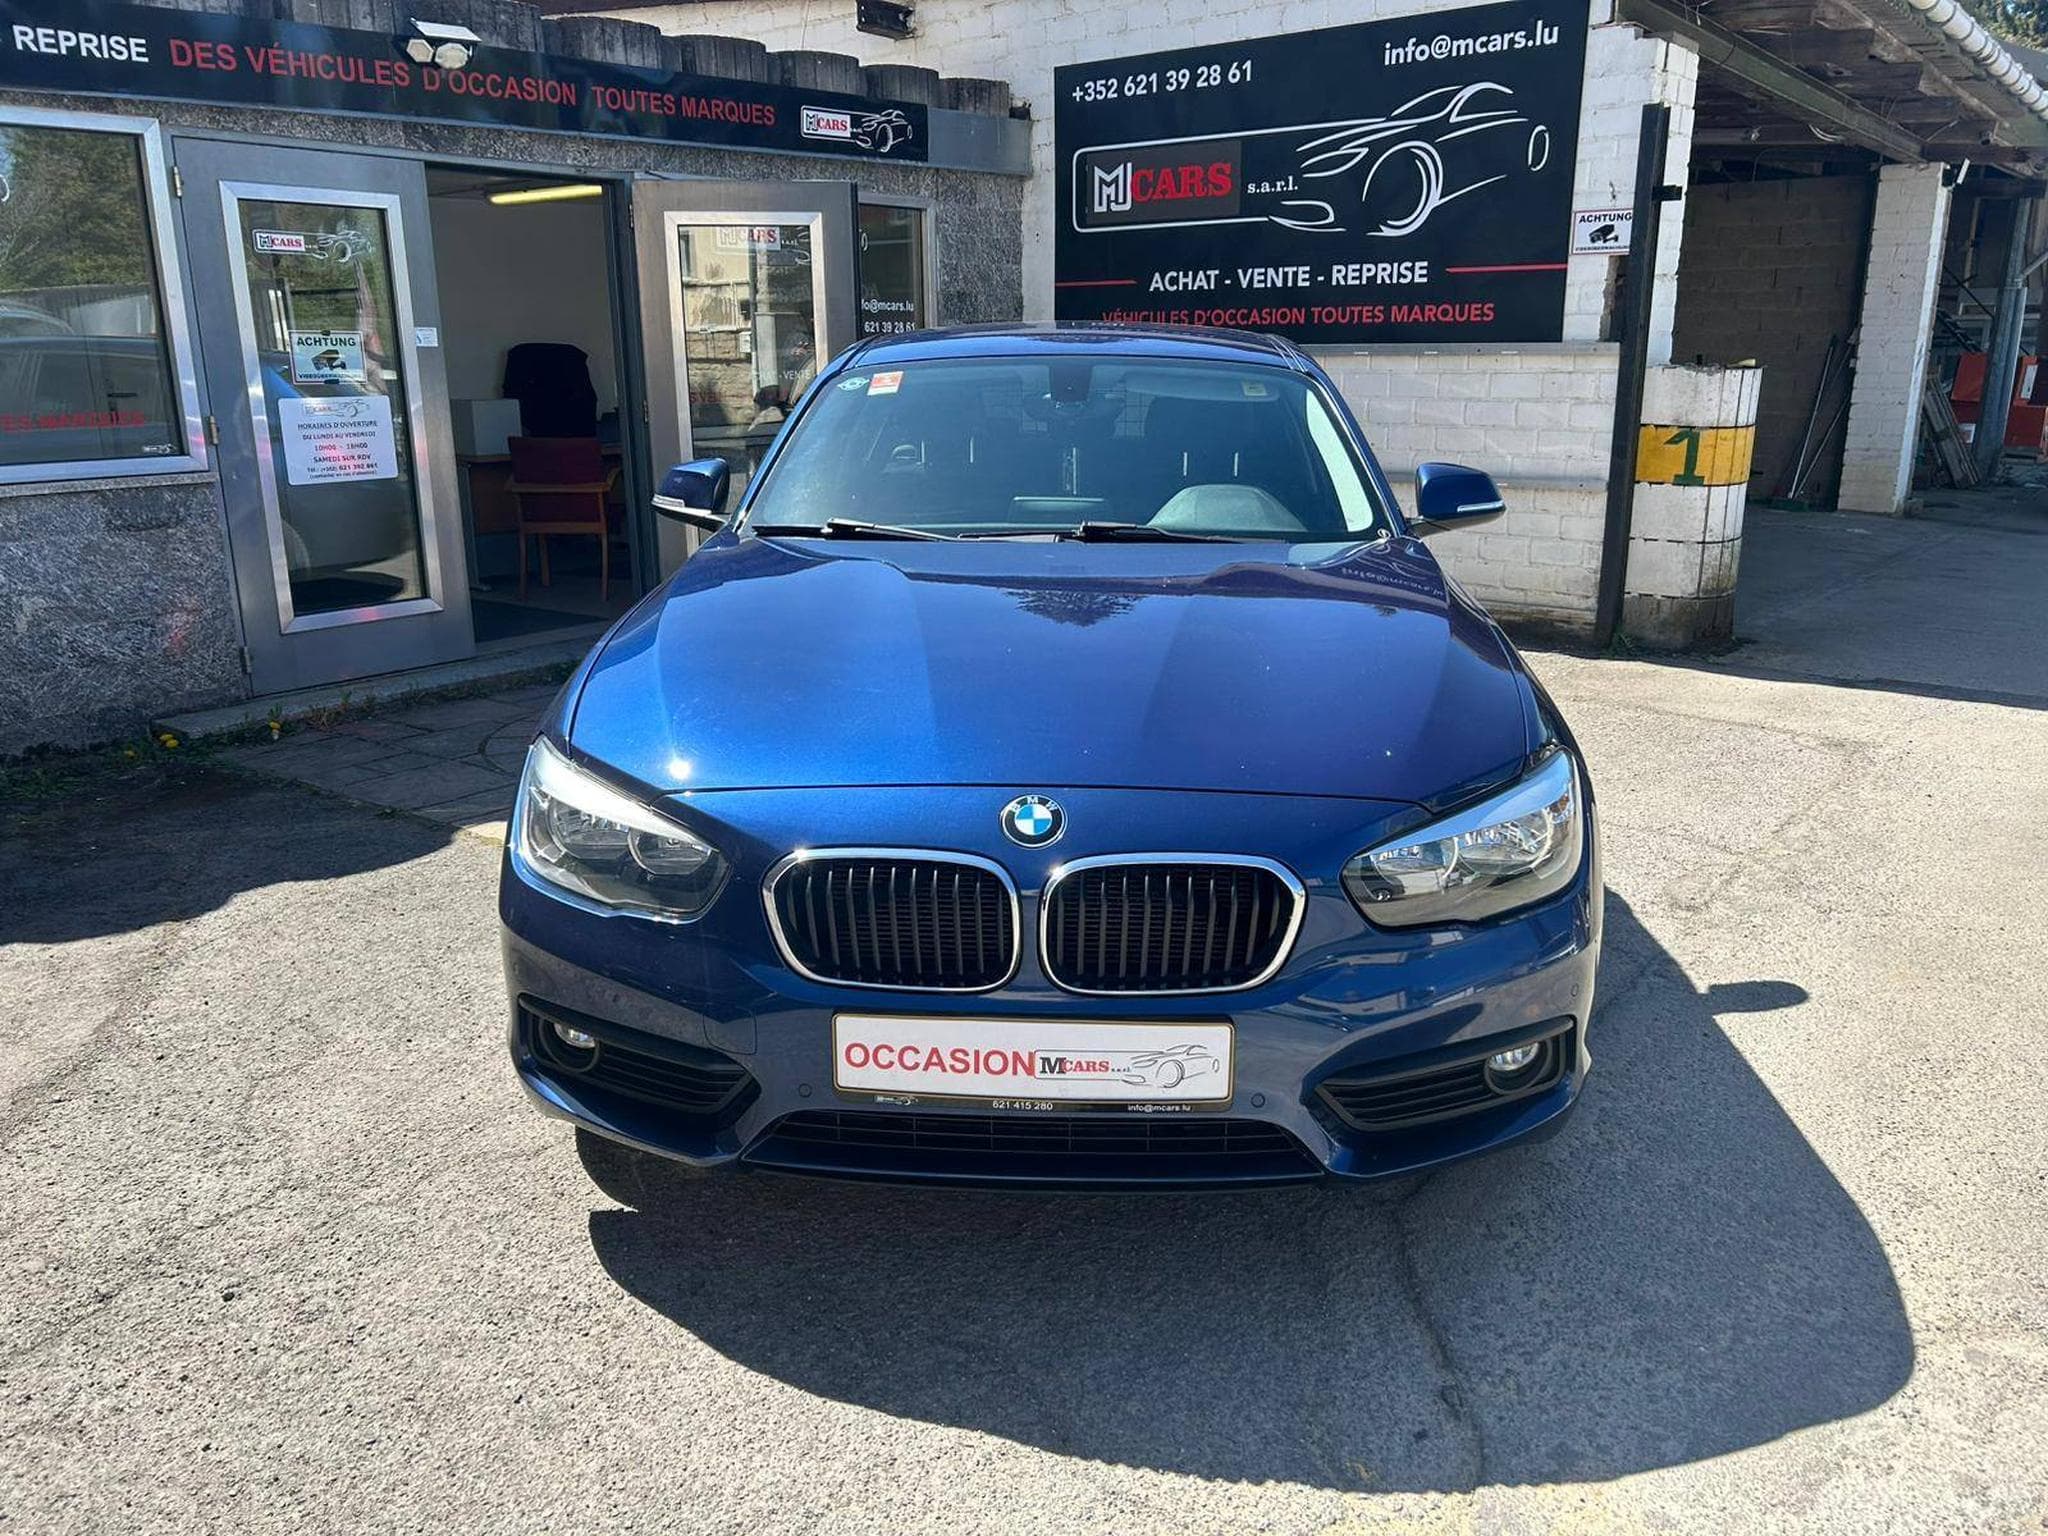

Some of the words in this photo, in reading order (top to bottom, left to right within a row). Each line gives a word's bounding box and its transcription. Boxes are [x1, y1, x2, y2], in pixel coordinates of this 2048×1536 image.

[1383, 20, 1560, 67] info@mcars.lu
[12, 24, 149, 63] REPRISE
[169, 38, 237, 72] DES
[245, 42, 410, 88] VÉHICULES
[592, 86, 676, 115] TOUTES
[681, 96, 776, 127] MARQUES
[1072, 79, 1118, 103] +352
[1124, 72, 1158, 96] 621
[1165, 68, 1190, 91] 39
[1196, 65, 1222, 88] 28
[1227, 60, 1253, 84] 61
[1579, 212, 1632, 224] ACHTUNG
[1149, 270, 1220, 293] ACHAT
[1237, 266, 1310, 290] VENTE
[1331, 261, 1429, 287] REPRISE
[864, 321, 879, 333] 621
[881, 321, 893, 333] 39
[1194, 307, 1304, 326] D'OCCASION
[1311, 306, 1385, 325] TOUTES
[1391, 303, 1495, 323] MARQUES
[297, 336, 357, 347] ACHTUNG
[1663, 430, 1705, 486] 1
[845, 1042, 1035, 1077] OCCASION
